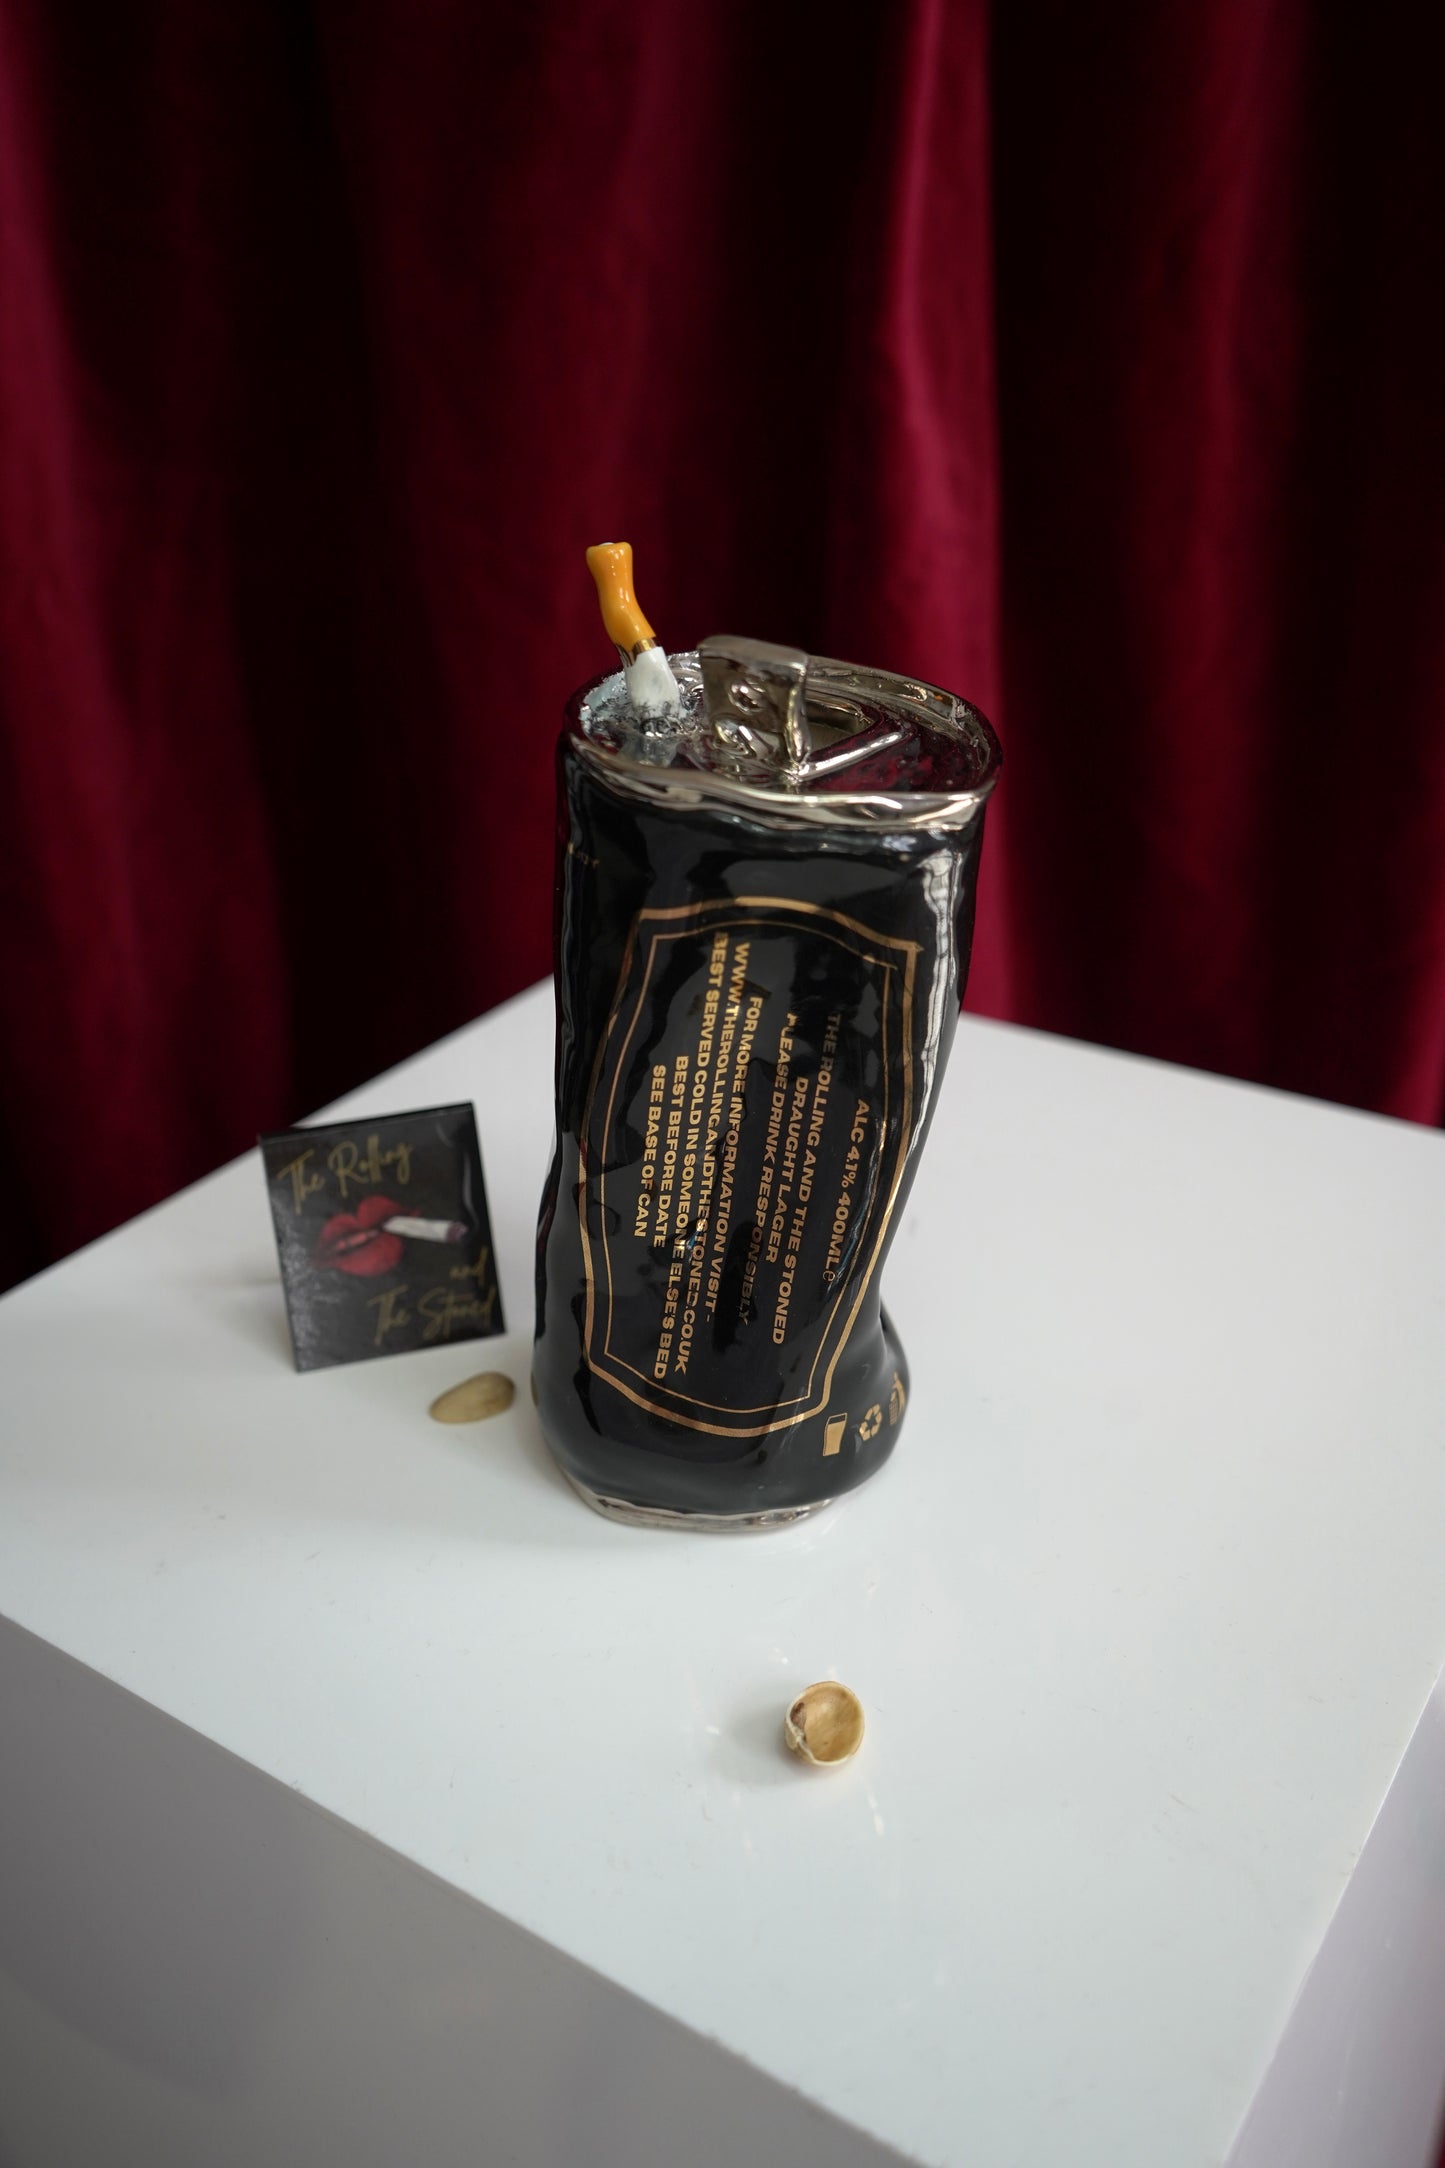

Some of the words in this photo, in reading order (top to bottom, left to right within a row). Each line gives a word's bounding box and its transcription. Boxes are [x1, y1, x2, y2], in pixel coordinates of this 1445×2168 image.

[709, 932, 729, 987] BEST
[697, 989, 720, 1067] SERVED
[743, 997, 763, 1031] FOR
[823, 1015, 840, 1053] THE
[650, 1065, 667, 1103] SEE
[671, 1056, 689, 1107] BEST
[732, 1034, 754, 1093] MORE
[689, 1070, 707, 1125] COLD
[807, 1056, 834, 1146] ROLLING
[851, 1099, 870, 1143] ALC
[643, 1106, 662, 1162] BASE
[660, 1111, 682, 1192] BEFORE
[686, 1128, 699, 1150] IN
[763, 1091, 785, 1165] DRINK
[782, 1076, 808, 1182] DRAUGHT
[277, 1149, 326, 1214] The
[641, 1165, 655, 1190] OF
[713, 1097, 743, 1252] INFORMATION
[799, 1149, 816, 1202] AND
[841, 1146, 860, 1188] 4.1%
[634, 1193, 651, 1237] CAN
[653, 1195, 671, 1248] DATE
[672, 1153, 696, 1259] SOMEONE
[765, 1184, 791, 1263] LAGER
[788, 1206, 807, 1251] THE
[739, 1166, 774, 1325] RESPONSIBLY
[662, 1262, 683, 1330] ELSE'S
[705, 1257, 724, 1313] VISIT
[773, 1254, 797, 1344] STONED
[653, 1332, 673, 1379] BED
